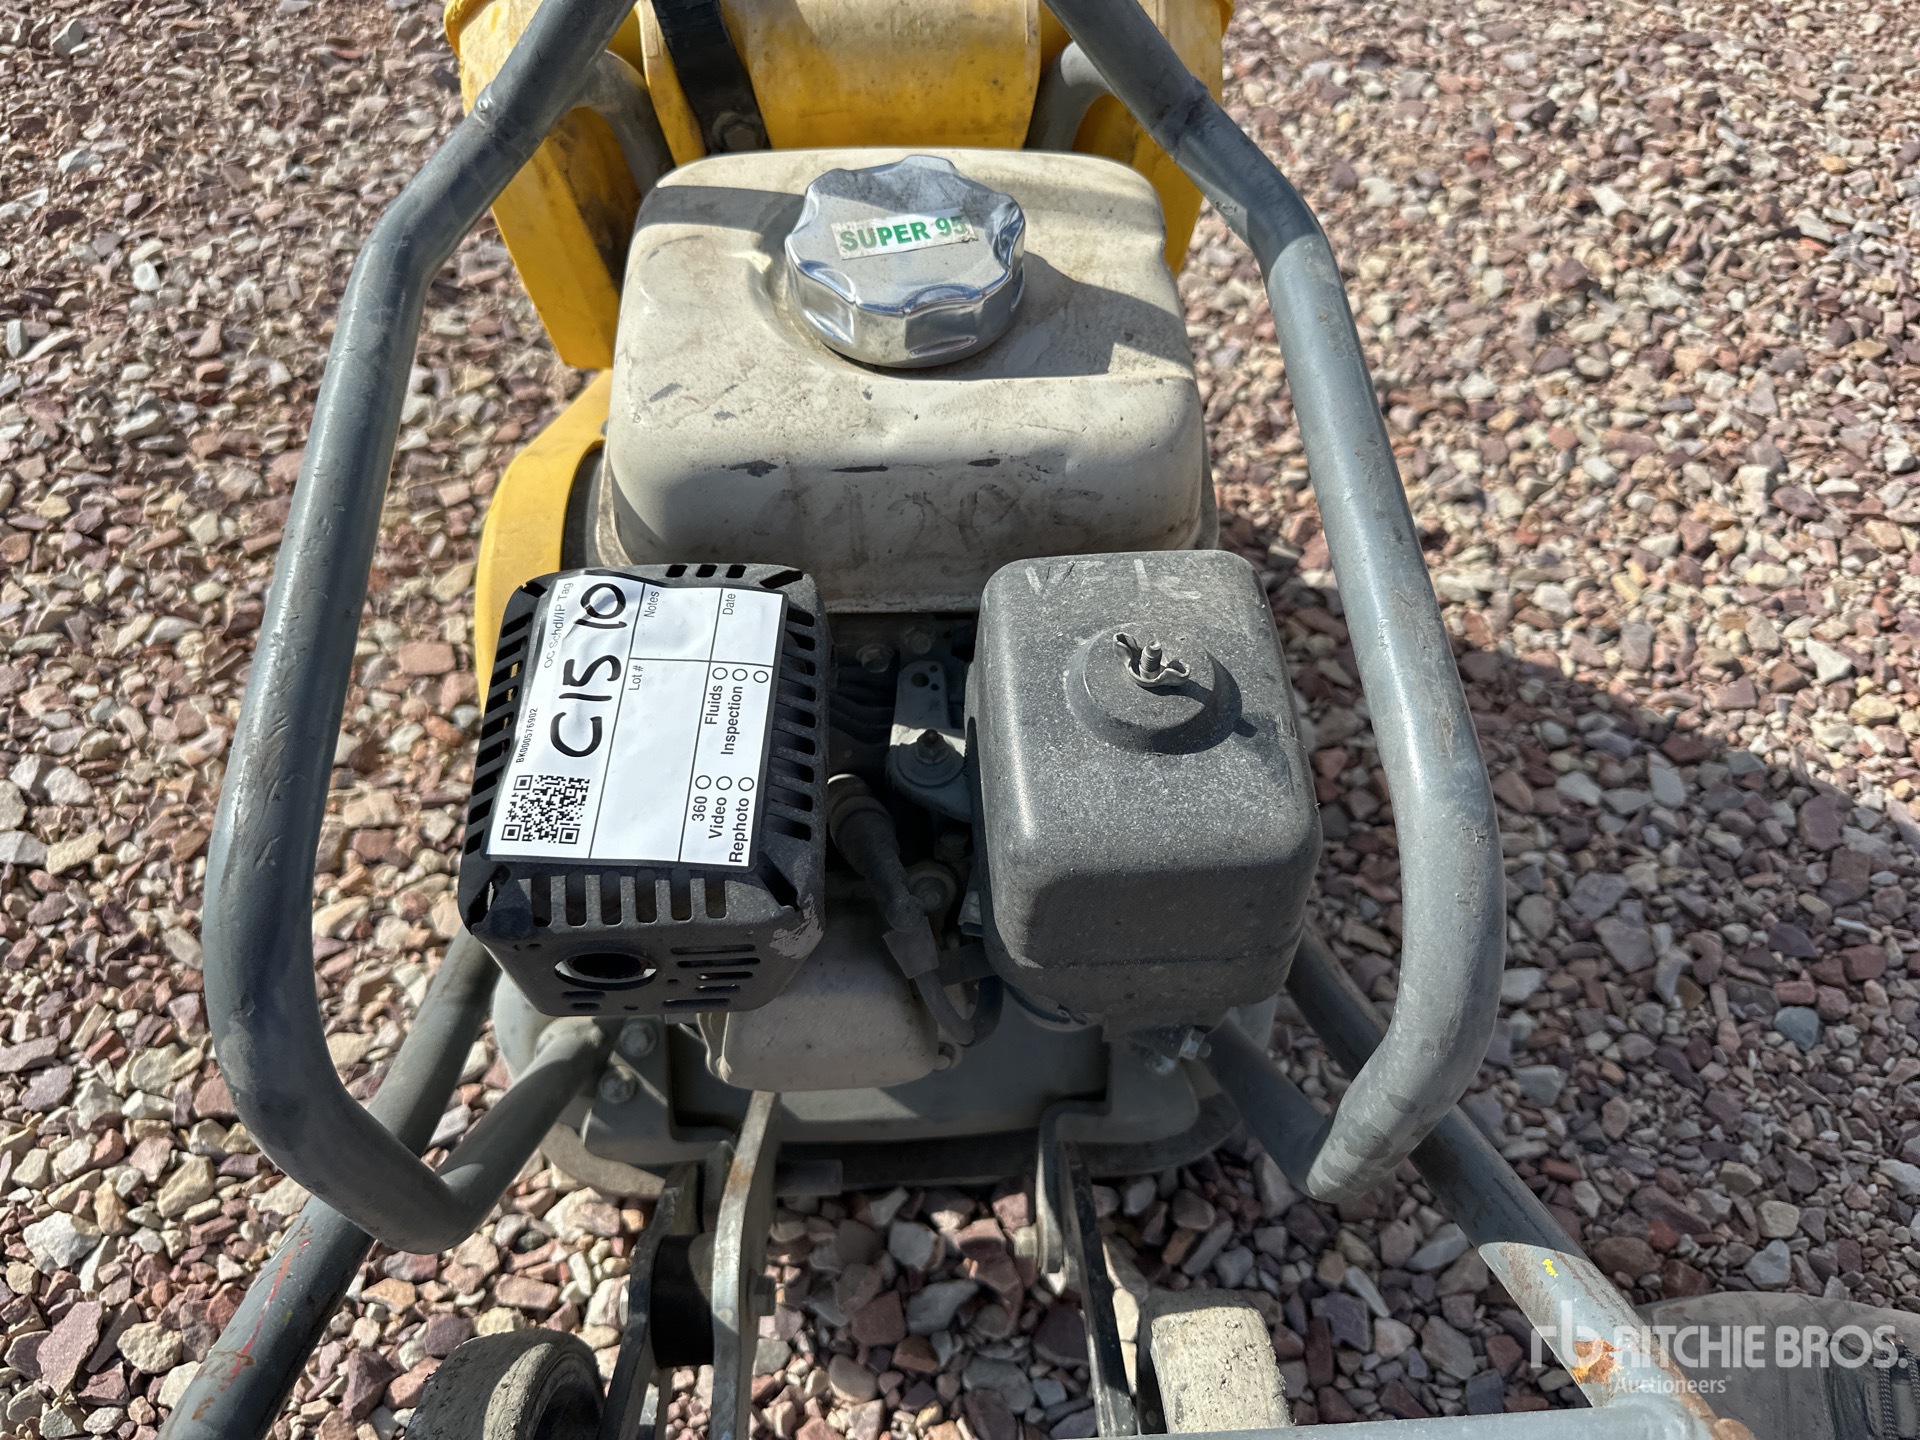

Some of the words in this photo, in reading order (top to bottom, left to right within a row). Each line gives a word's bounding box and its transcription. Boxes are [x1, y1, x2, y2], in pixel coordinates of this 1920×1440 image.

[840, 221, 931, 251] SUPER
[935, 215, 969, 238] 95
[643, 591, 660, 618] Notes
[722, 593, 736, 615] Date
[543, 650, 556, 669] OC
[557, 582, 574, 602] Tag
[628, 675, 642, 691] Lot
[704, 685, 723, 725] Fluids
[720, 686, 743, 755] Inspection
[515, 707, 539, 763] BK000576902
[691, 796, 708, 822] 360
[708, 797, 727, 839] Video
[728, 798, 750, 863] Rephoto
